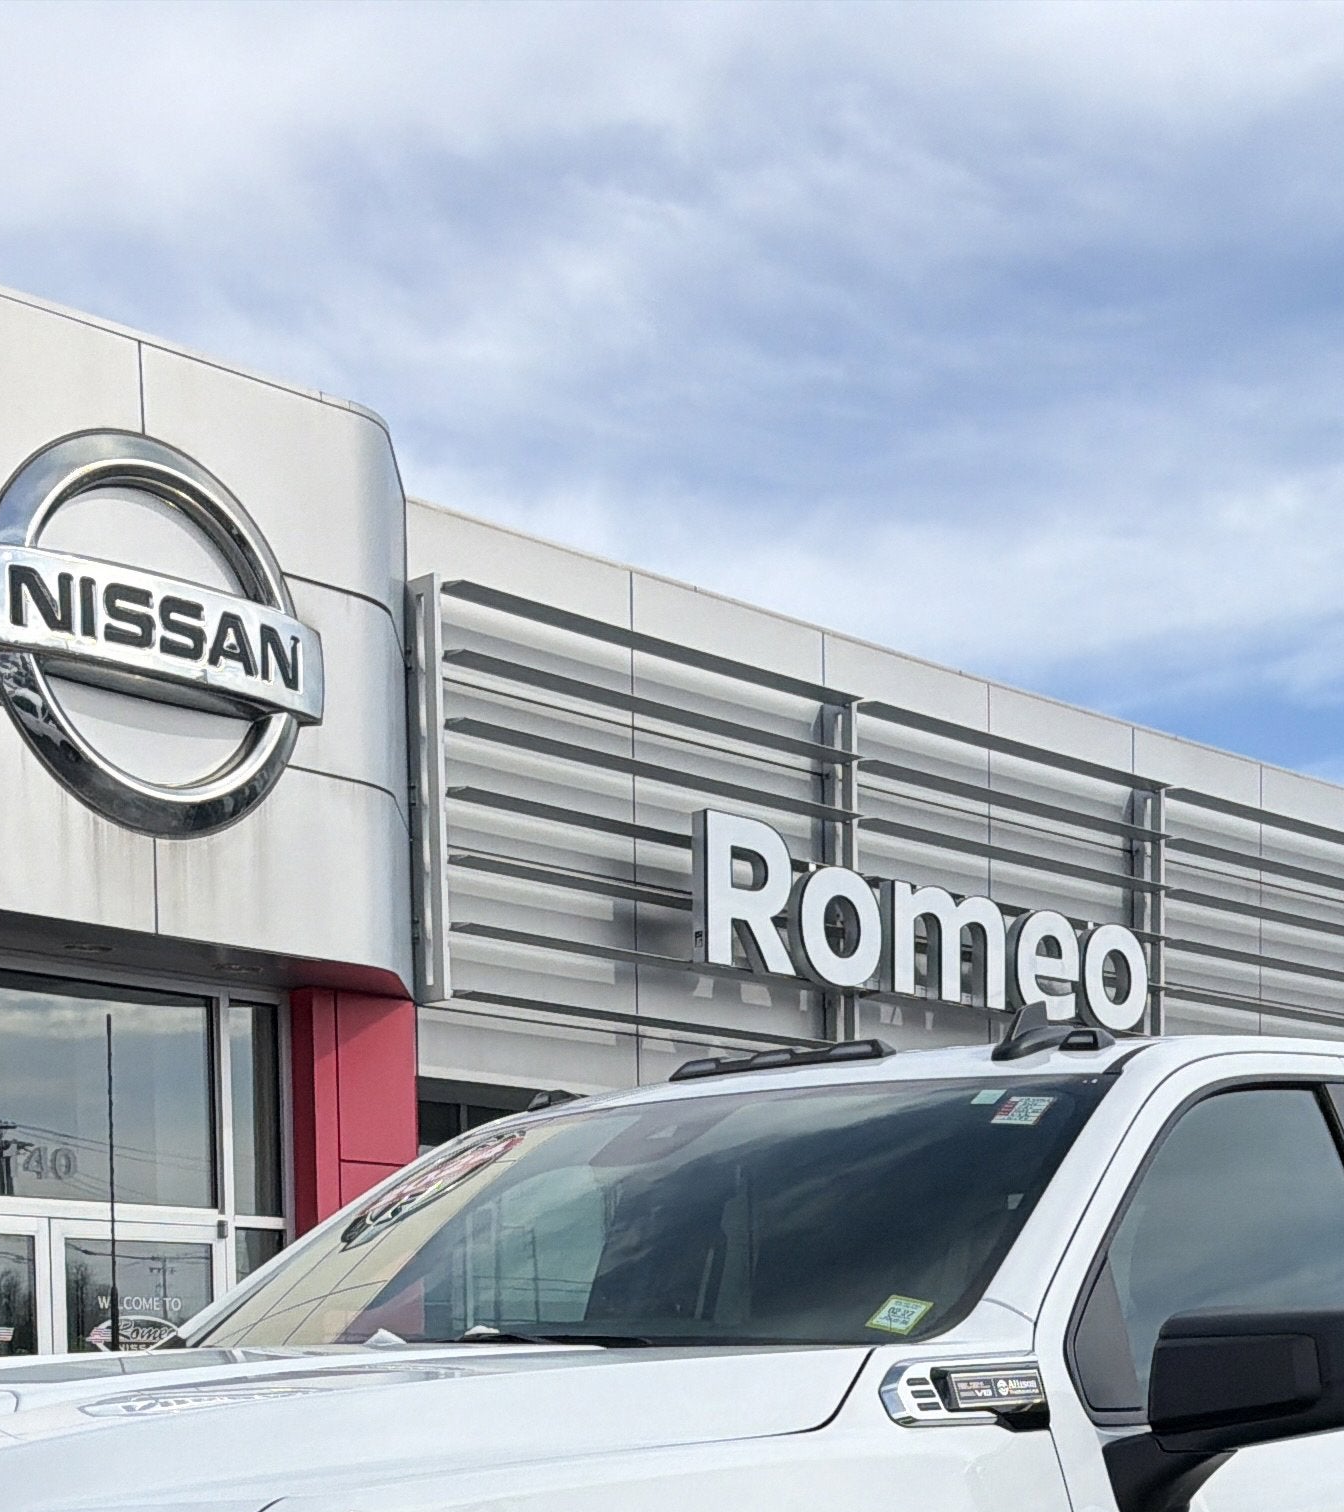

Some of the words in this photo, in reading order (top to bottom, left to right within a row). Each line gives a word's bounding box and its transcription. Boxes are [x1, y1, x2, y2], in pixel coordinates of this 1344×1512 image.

[8, 563, 302, 690] NISSAN
[692, 808, 1149, 1031] Romeo
[97, 1295, 161, 1311] WLCOME
[163, 1297, 183, 1312] TO
